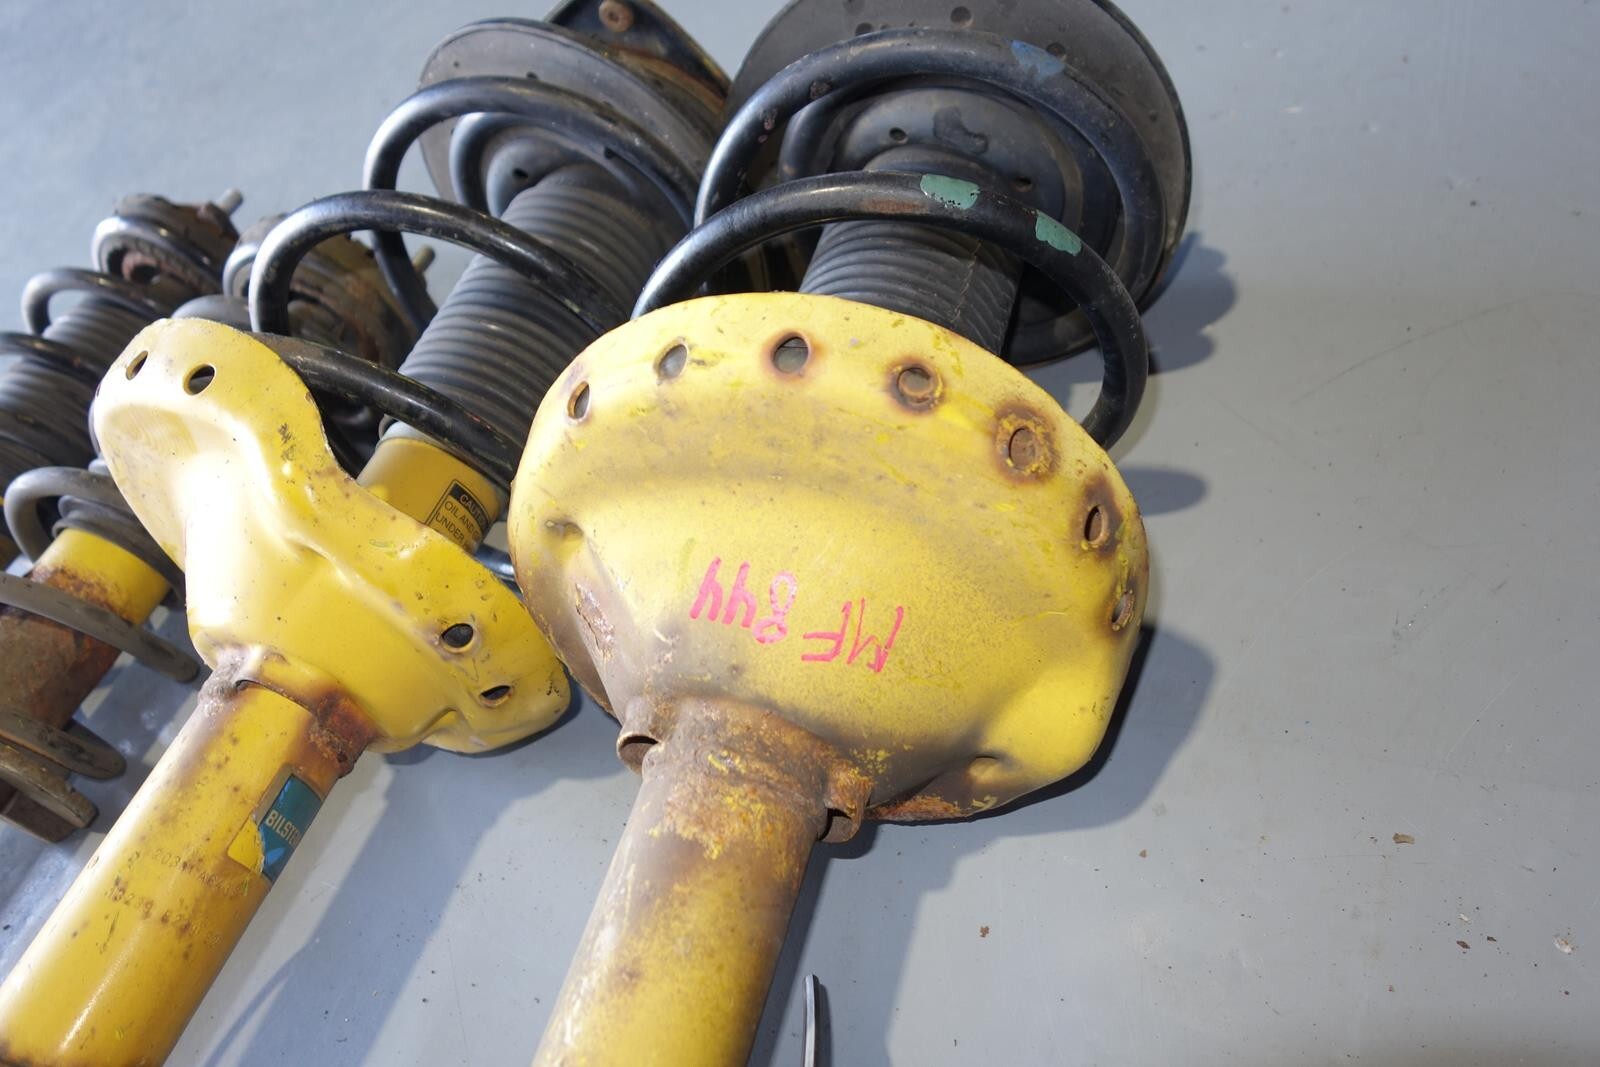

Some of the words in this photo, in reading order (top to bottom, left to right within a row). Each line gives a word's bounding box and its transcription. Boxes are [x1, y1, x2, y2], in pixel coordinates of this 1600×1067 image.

[435, 511, 465, 541] UNDER
[444, 501, 459, 518] OIL
[460, 515, 476, 532] AND
[801, 597, 904, 673] MF
